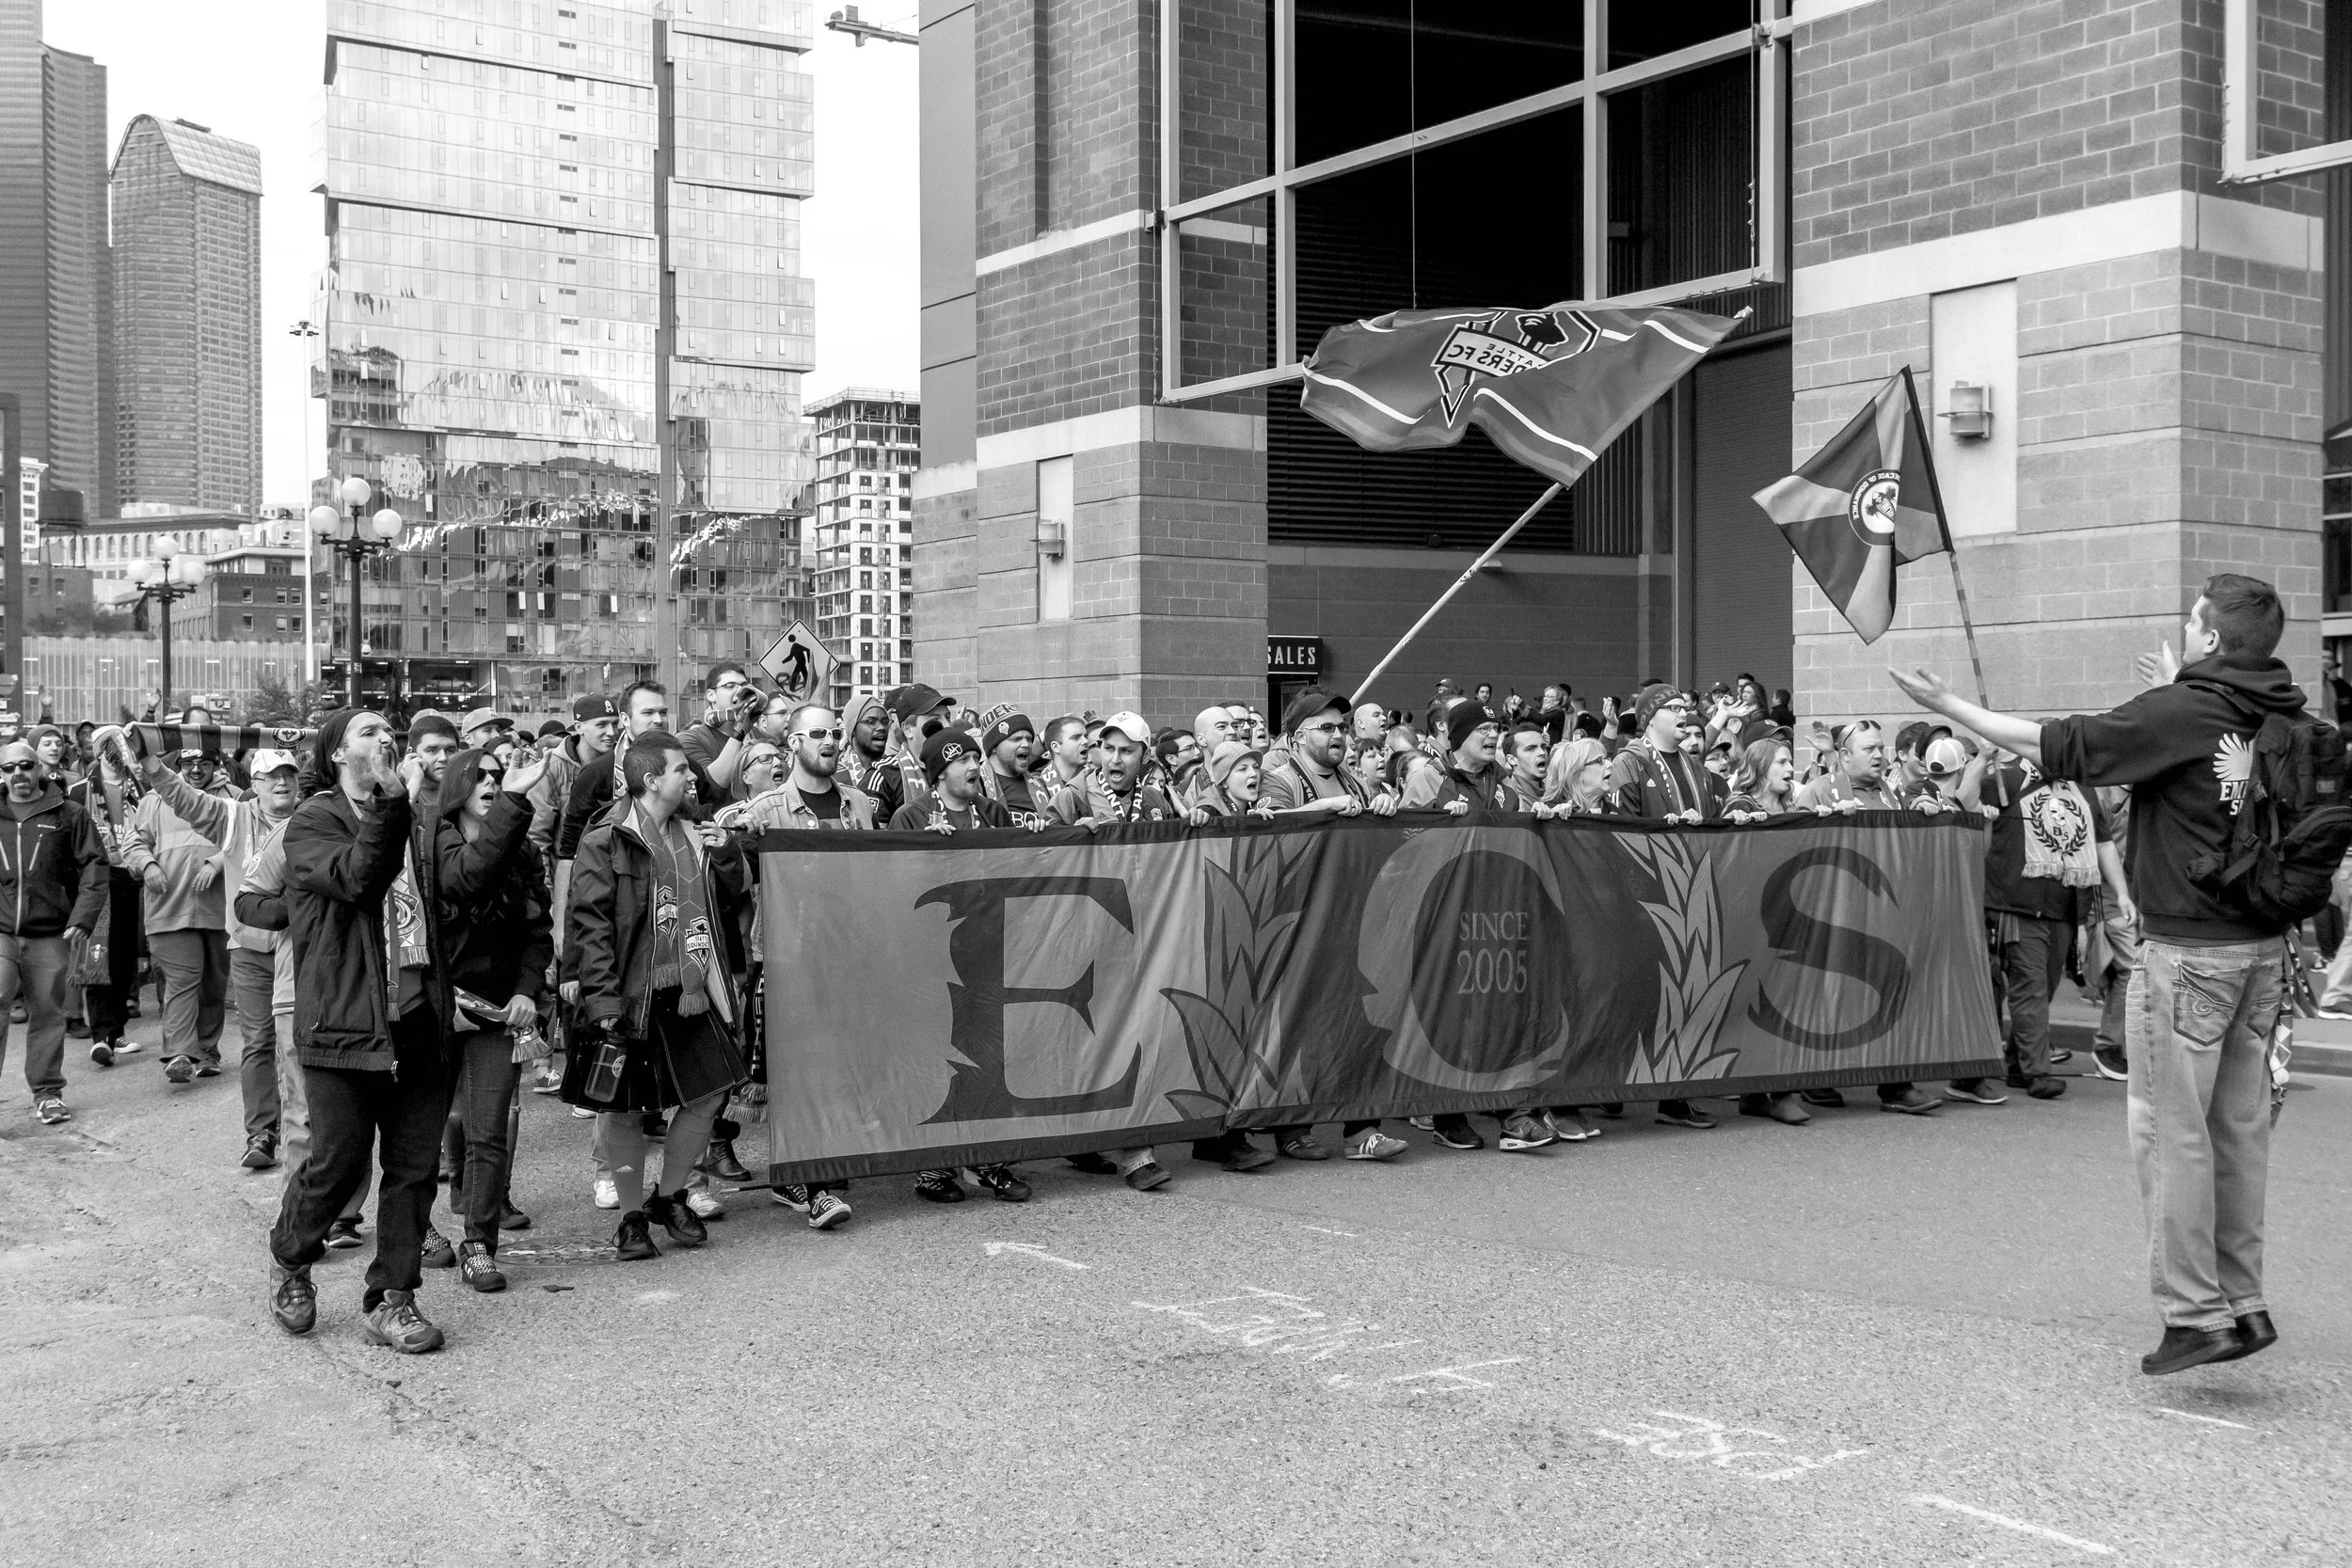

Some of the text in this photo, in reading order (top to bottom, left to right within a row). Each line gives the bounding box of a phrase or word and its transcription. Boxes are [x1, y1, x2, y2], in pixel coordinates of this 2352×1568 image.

[980, 704, 1017, 731] NDER
[1098, 770, 1125, 818] OUNT
[1010, 812, 1039, 828] BO
[1459, 911, 1528, 941] SINCE
[1457, 948, 1528, 994] 2005
